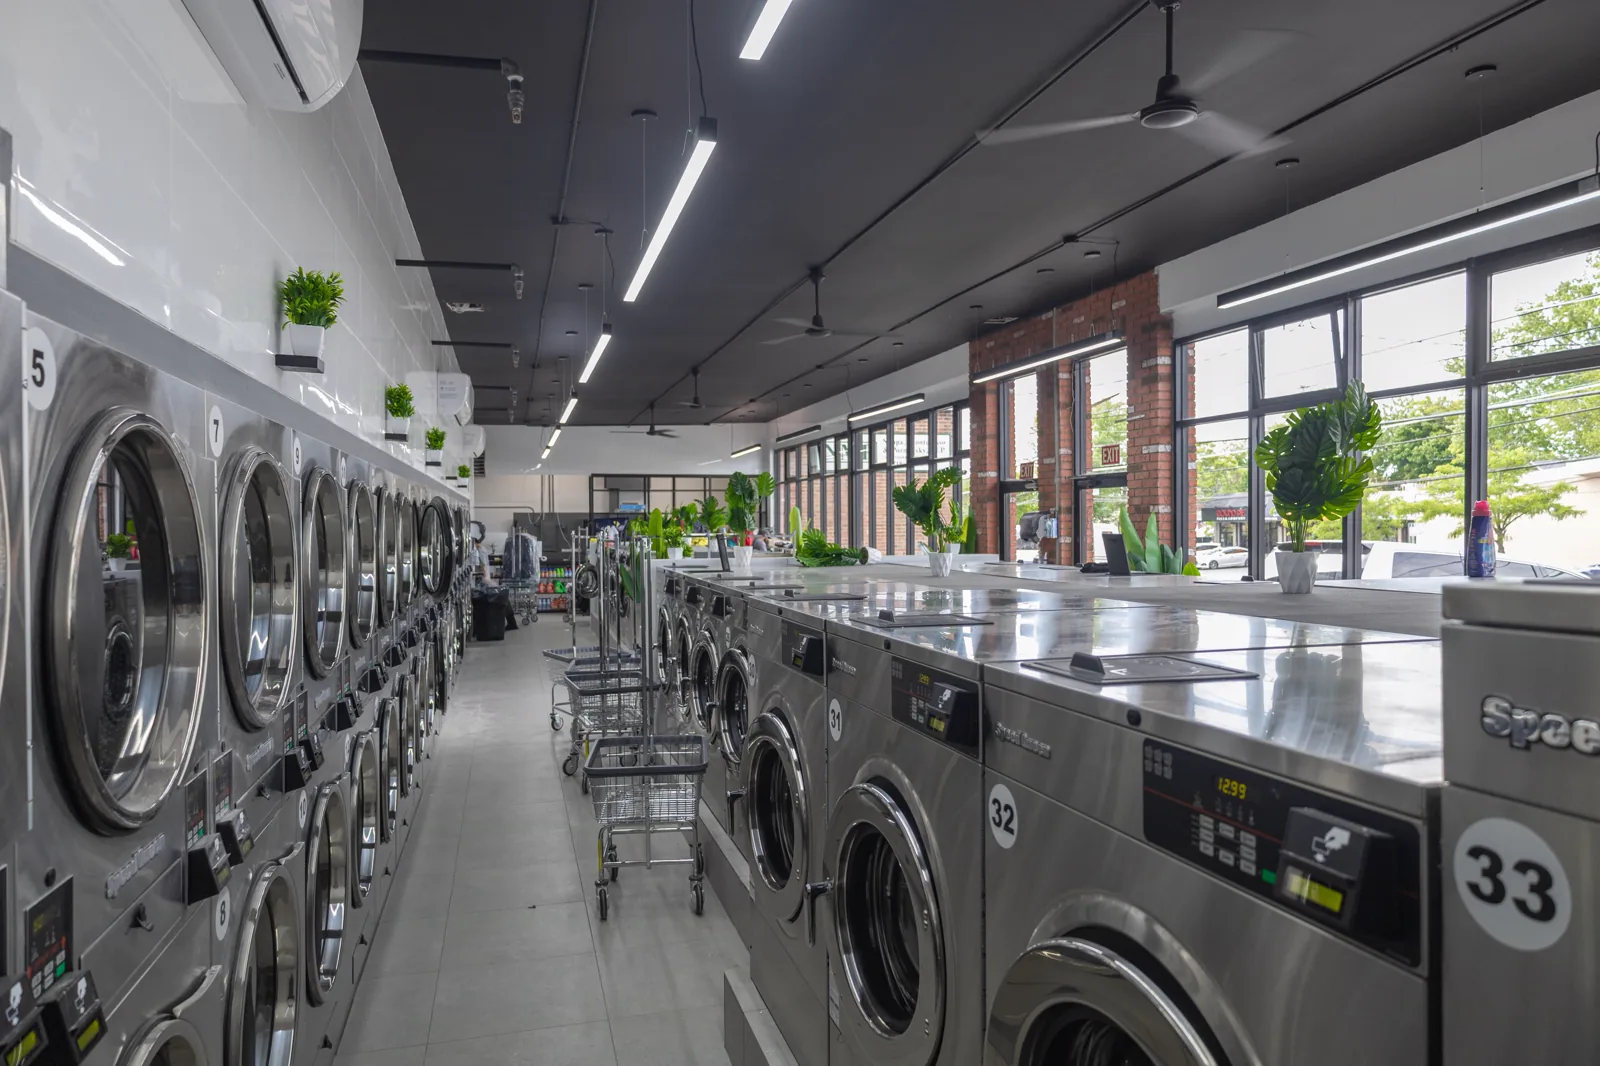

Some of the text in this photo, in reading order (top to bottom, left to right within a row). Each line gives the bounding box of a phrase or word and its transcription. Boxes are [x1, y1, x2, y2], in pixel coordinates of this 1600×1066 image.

[32, 348, 45, 388] 5
[213, 418, 220, 443] 7
[1103, 446, 1120, 463] EXIT
[1020, 464, 1034, 478] EXIT
[831, 708, 841, 732] 31
[992, 797, 1015, 836] 32
[1465, 844, 1556, 924] 33
[219, 900, 226, 926] 8
